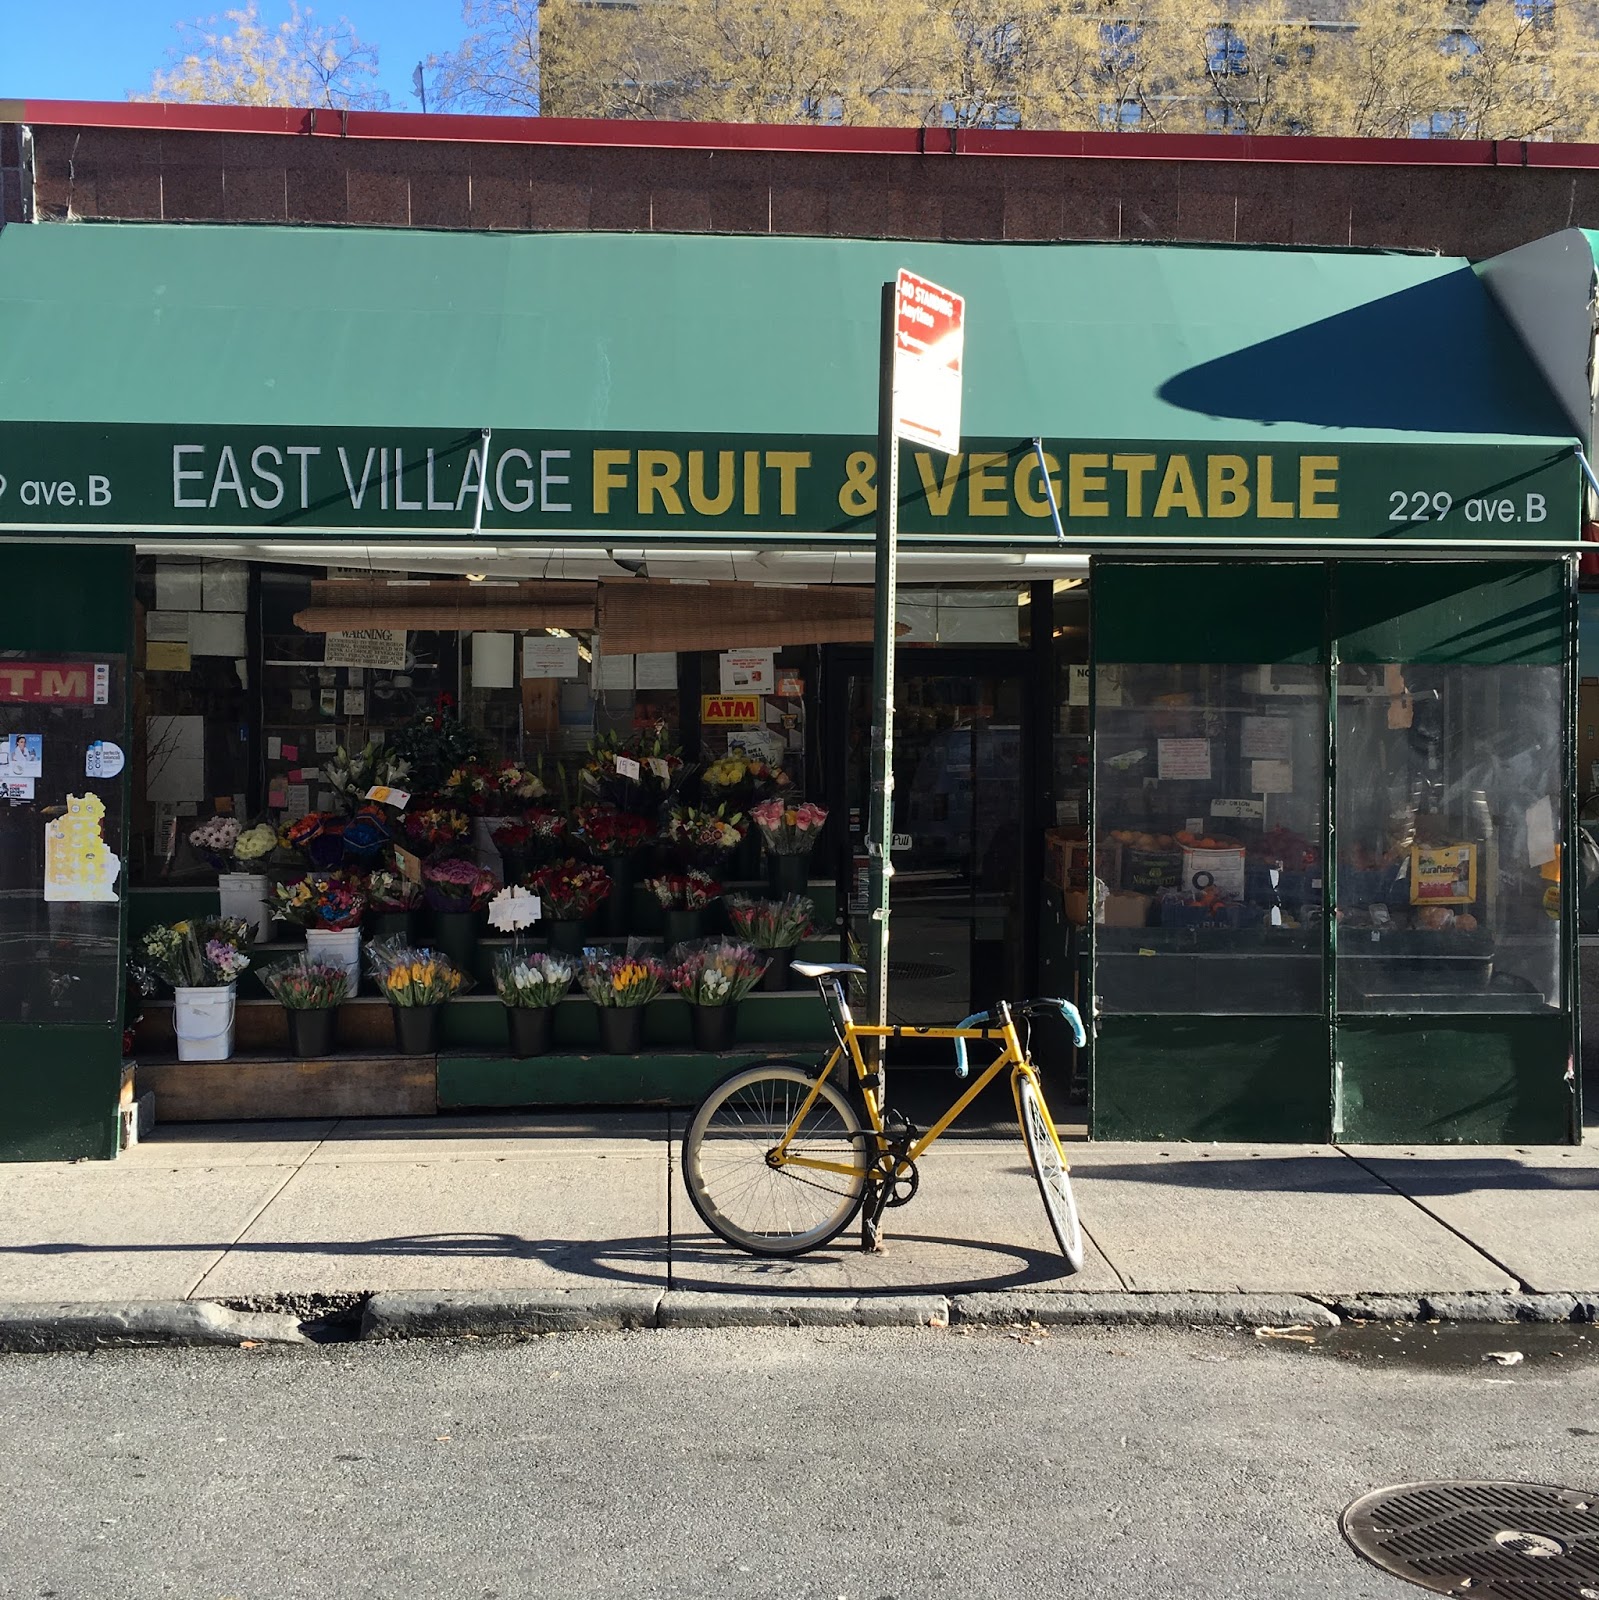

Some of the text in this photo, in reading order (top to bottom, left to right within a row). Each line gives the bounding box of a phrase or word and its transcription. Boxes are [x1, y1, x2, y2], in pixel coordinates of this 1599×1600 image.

[901, 279, 953, 318] NO STANDING
[901, 300, 935, 328] Anytime
[173, 445, 1339, 519] EAST VILLAGE FRUIT & VEGETABLE
[1388, 491, 1453, 521] 229
[341, 629, 392, 641] WARNING:
[706, 701, 755, 717] ATM
[892, 834, 909, 846] Pull
